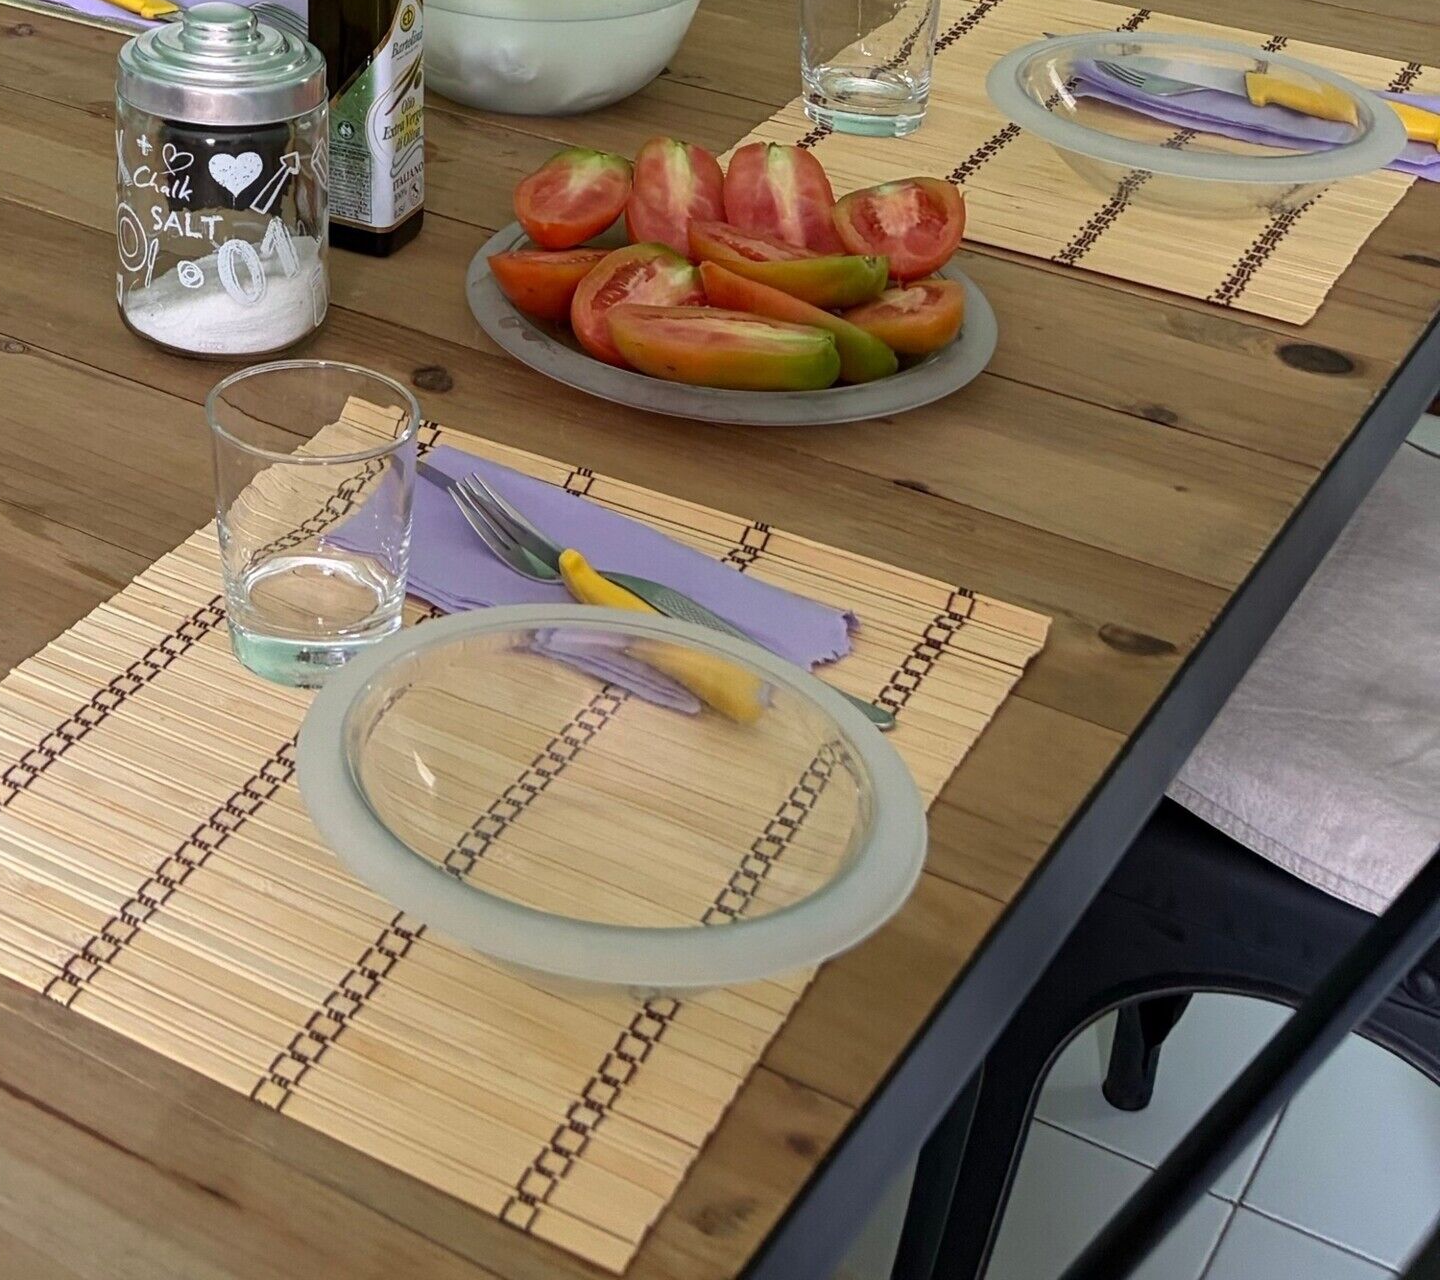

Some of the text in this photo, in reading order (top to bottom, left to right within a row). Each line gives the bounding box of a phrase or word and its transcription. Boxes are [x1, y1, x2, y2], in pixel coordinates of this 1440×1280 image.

[401, 96, 415, 115] Olio
[382, 119, 405, 141] Extra
[133, 165, 194, 203] Chalk
[392, 161, 424, 193] ITALIANO
[150, 205, 224, 241] SALT
